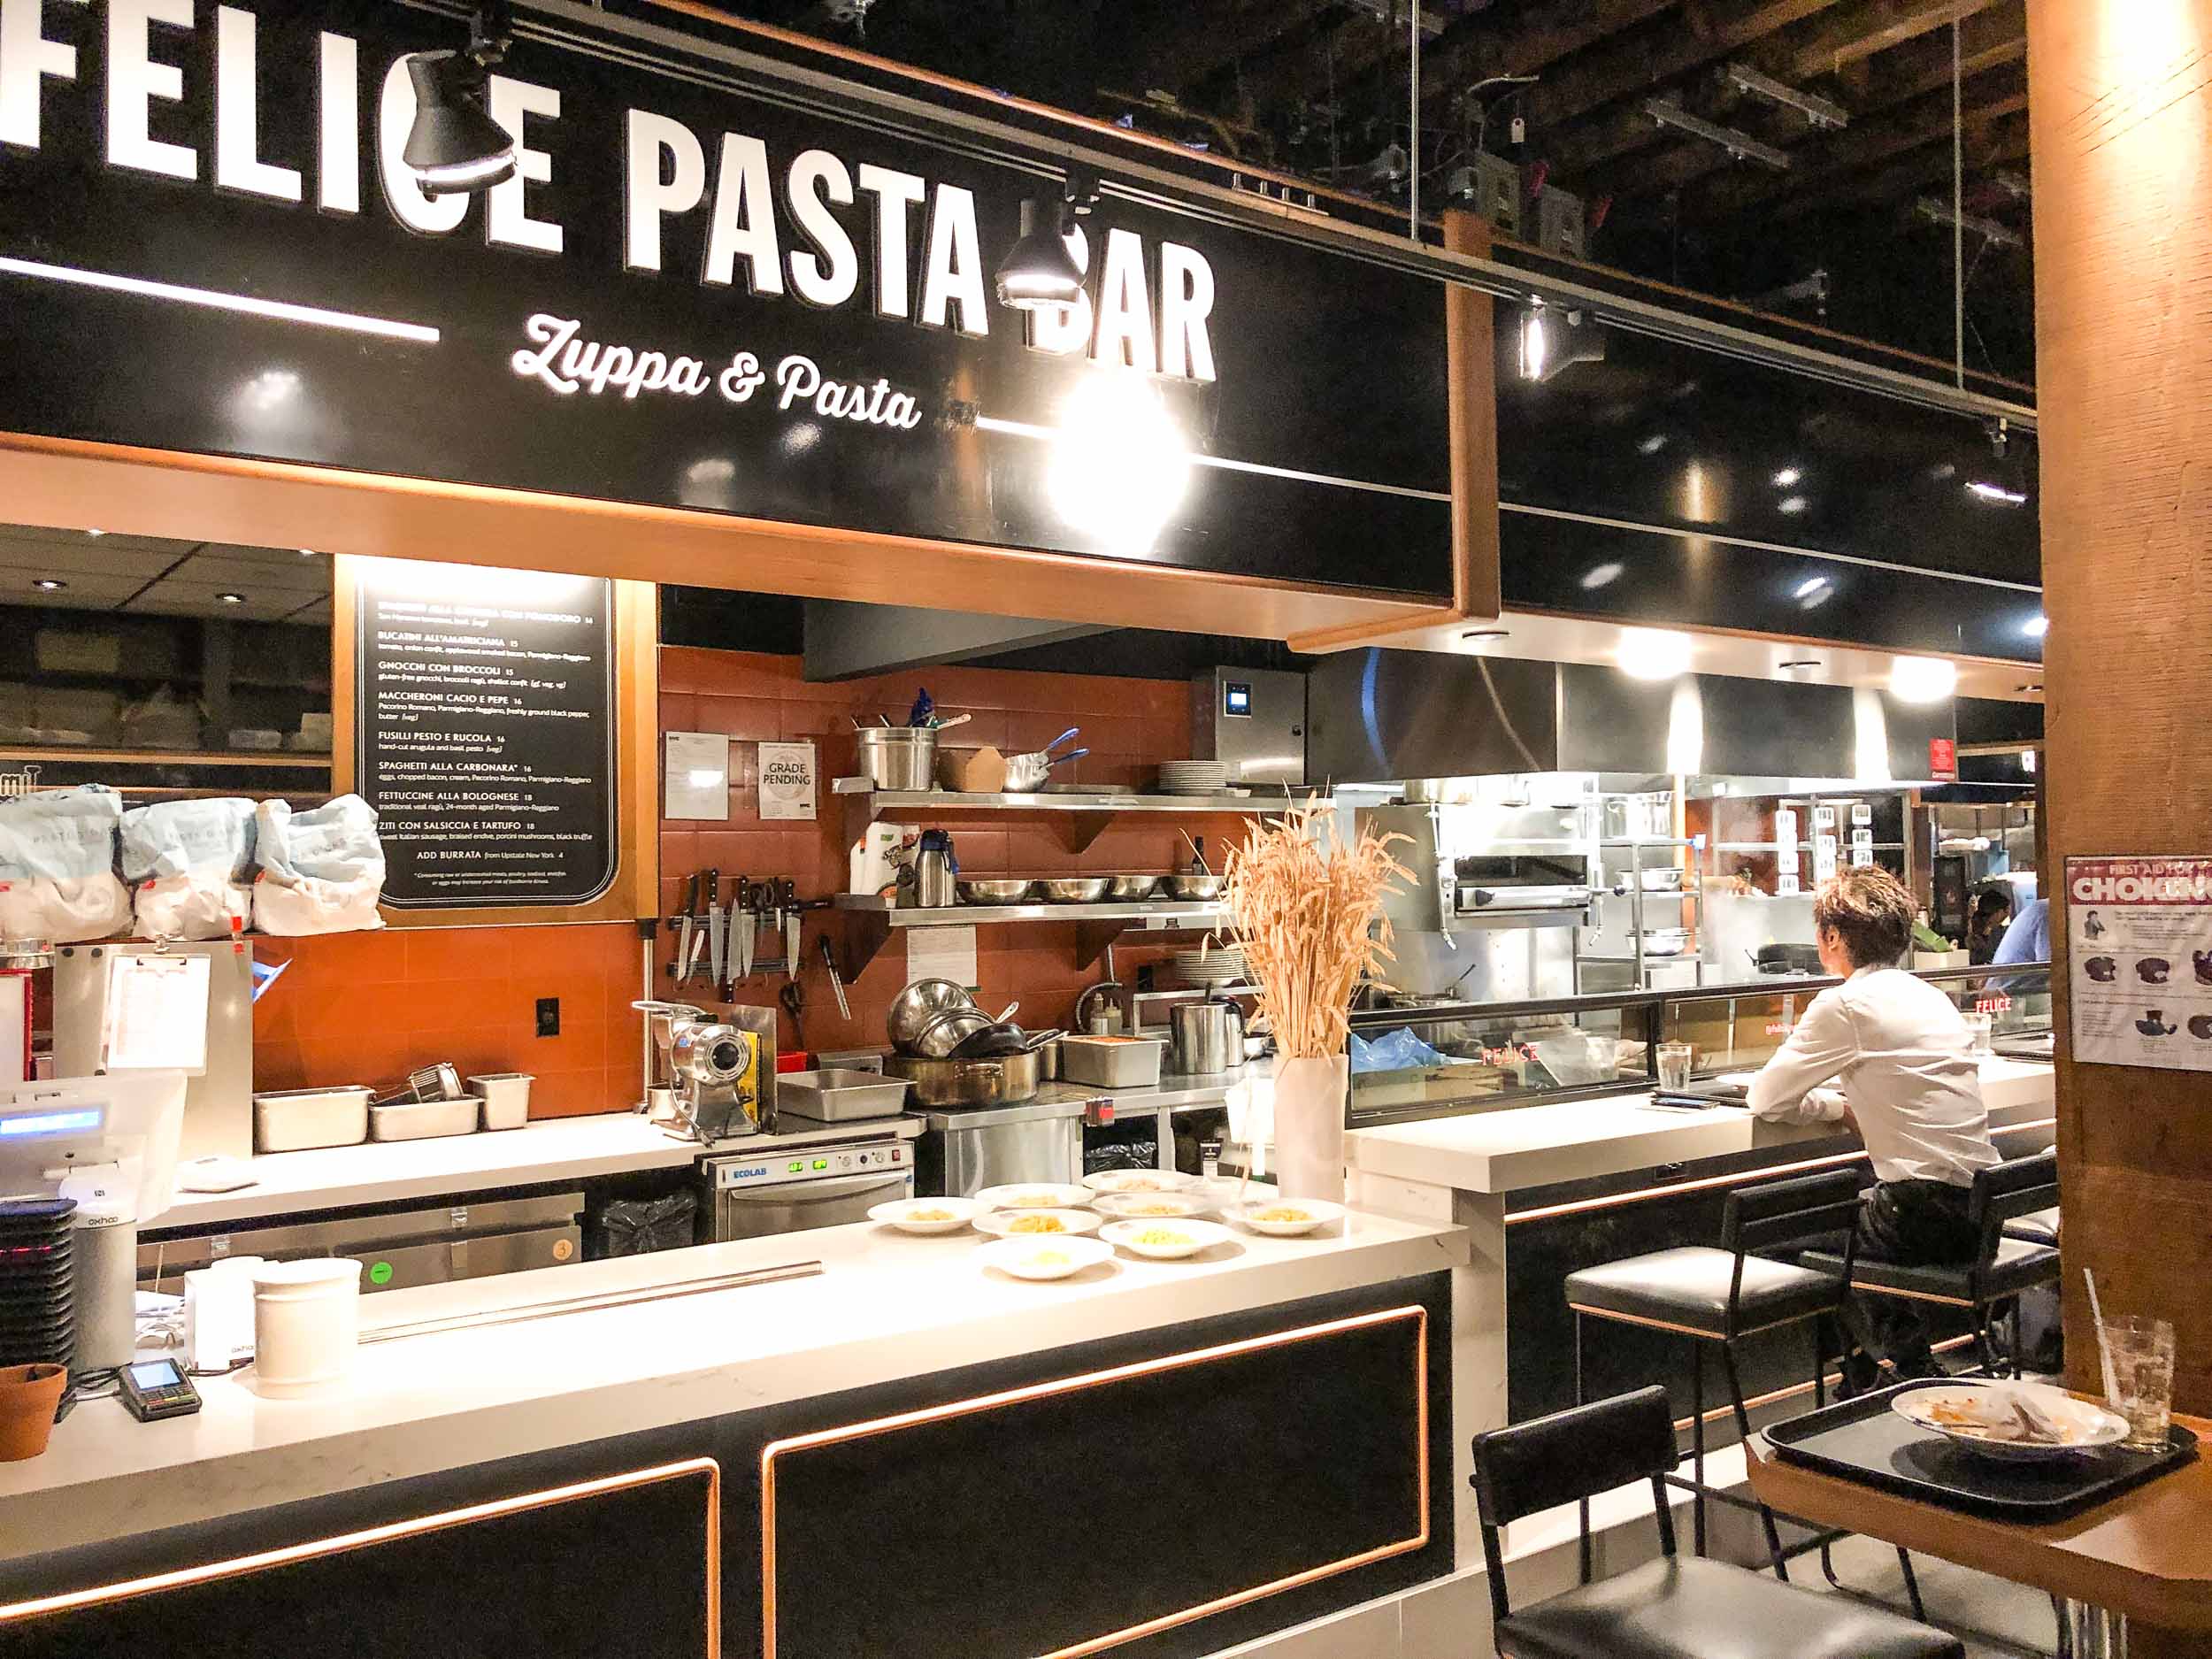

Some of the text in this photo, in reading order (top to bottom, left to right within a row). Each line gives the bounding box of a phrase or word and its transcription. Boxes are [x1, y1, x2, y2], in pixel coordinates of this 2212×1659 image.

[0, 0, 564, 254] FELICE
[626, 107, 989, 336] PASTA
[511, 313, 922, 430] Zuppa & Pasta
[378, 631, 421, 641] BUCATINI
[378, 661, 426, 672] GNOCCHI
[428, 664, 450, 672] CON
[453, 664, 501, 675] BROCCOLI
[378, 692, 443, 702] MACCHERONI
[446, 695, 477, 703] CACIO
[488, 695, 509, 704] PEPE
[378, 731, 411, 741] FUSILLI
[413, 733, 442, 741] PESTO
[445, 733, 450, 741] E
[453, 733, 492, 742] RUCOLA
[410, 744, 434, 753] arugula
[378, 761, 427, 770] SPAGHETTI
[769, 763, 806, 773] GRADE
[764, 774, 811, 785] PENDING
[379, 792, 434, 801] FETTUCCINE
[440, 850, 482, 859] BURRATA
[2109, 864, 2139, 875] FIRST
[2143, 864, 2164, 874] AID
[1976, 997, 2011, 1014] FELICE
[733, 1167, 767, 1179] ECOLAB
